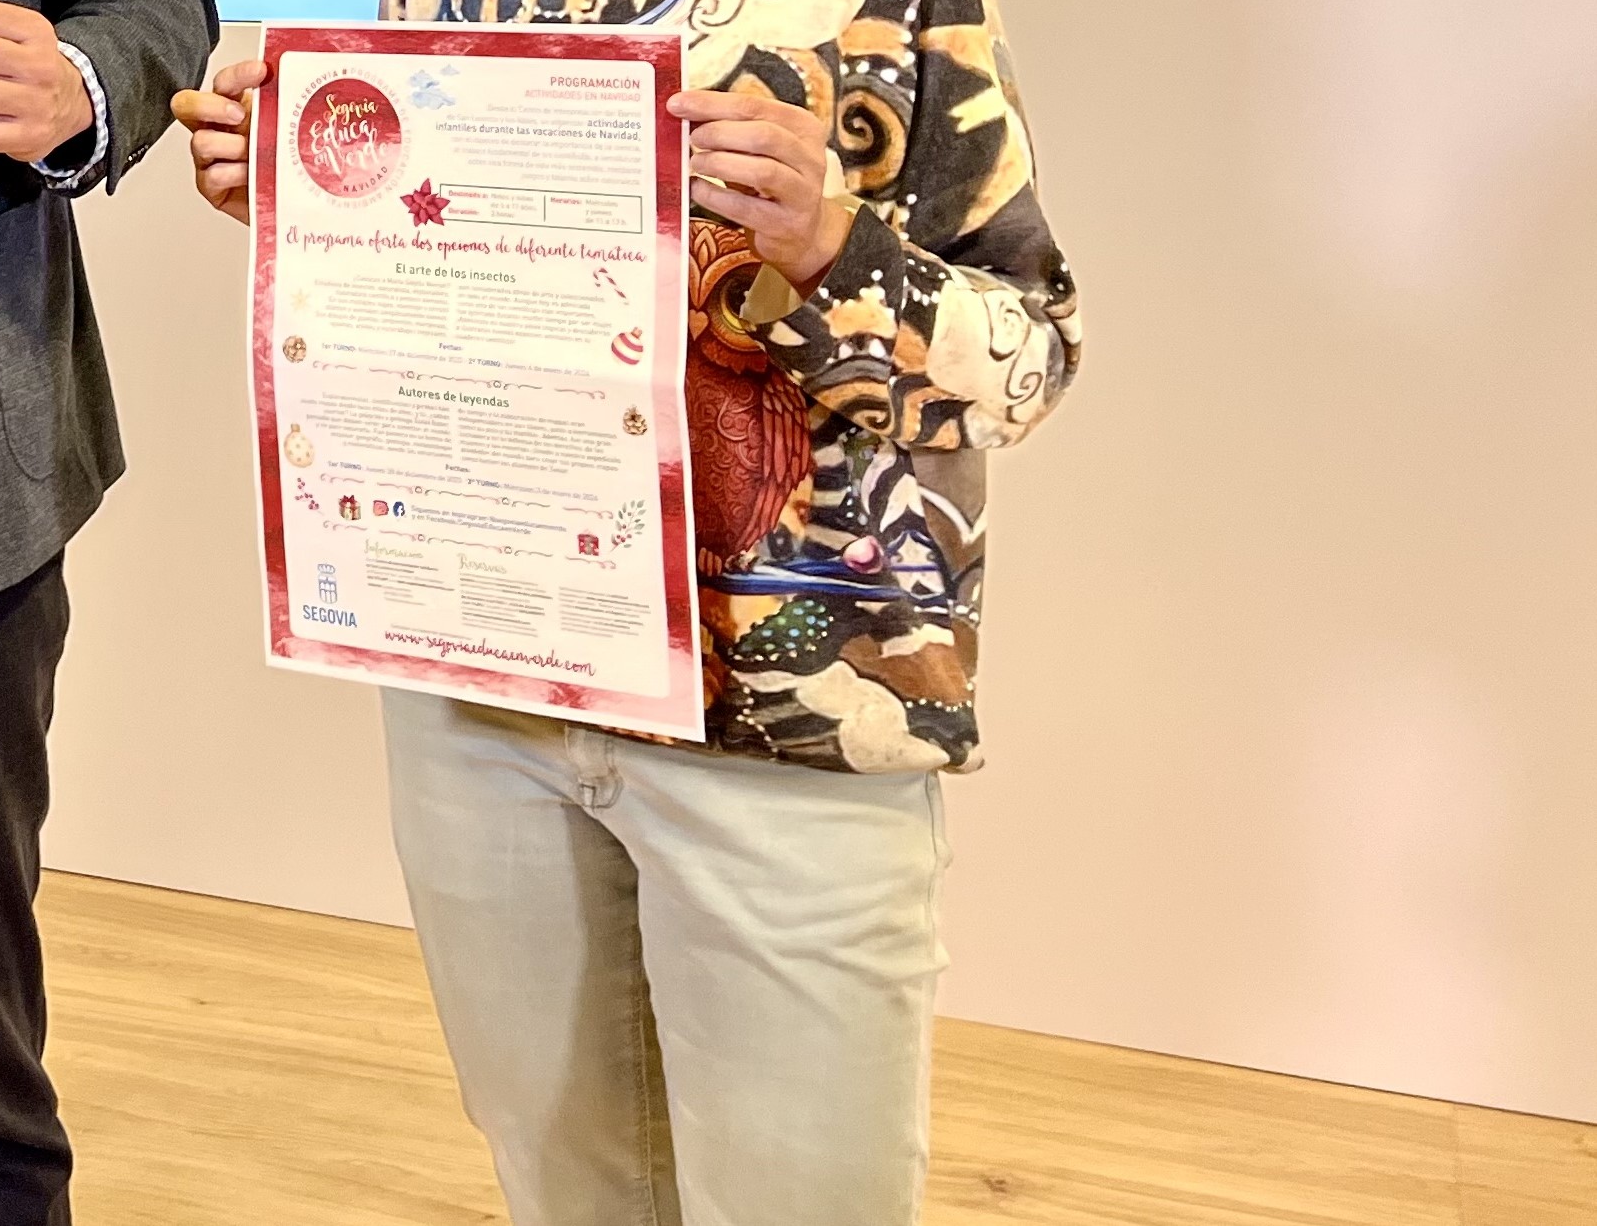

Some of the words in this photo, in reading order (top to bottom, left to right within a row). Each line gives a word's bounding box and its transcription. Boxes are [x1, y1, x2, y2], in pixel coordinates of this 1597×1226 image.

[550, 76, 641, 89] PROGRAMACIÓN
[325, 93, 379, 125] Segovia
[309, 112, 371, 154] Educa
[436, 122, 477, 133] infantiles
[479, 124, 514, 135] durante
[517, 125, 530, 135] las
[532, 128, 583, 140] vacaciones
[586, 129, 596, 138] de
[587, 119, 641, 130] actividades
[343, 166, 388, 193] NAVIDAD
[303, 232, 364, 253] programa
[368, 229, 408, 253] oferta
[411, 230, 433, 251] dos
[437, 241, 491, 261] opciones
[495, 235, 511, 253] de
[515, 236, 576, 263] diferente
[396, 263, 406, 274] El
[409, 265, 431, 276] arte
[434, 266, 448, 277] de
[451, 267, 467, 279] los
[470, 269, 516, 283] insectos
[398, 385, 440, 401] Autores
[443, 390, 456, 401] de
[459, 392, 510, 408] leyendas
[302, 605, 357, 628] SEGOVIA
